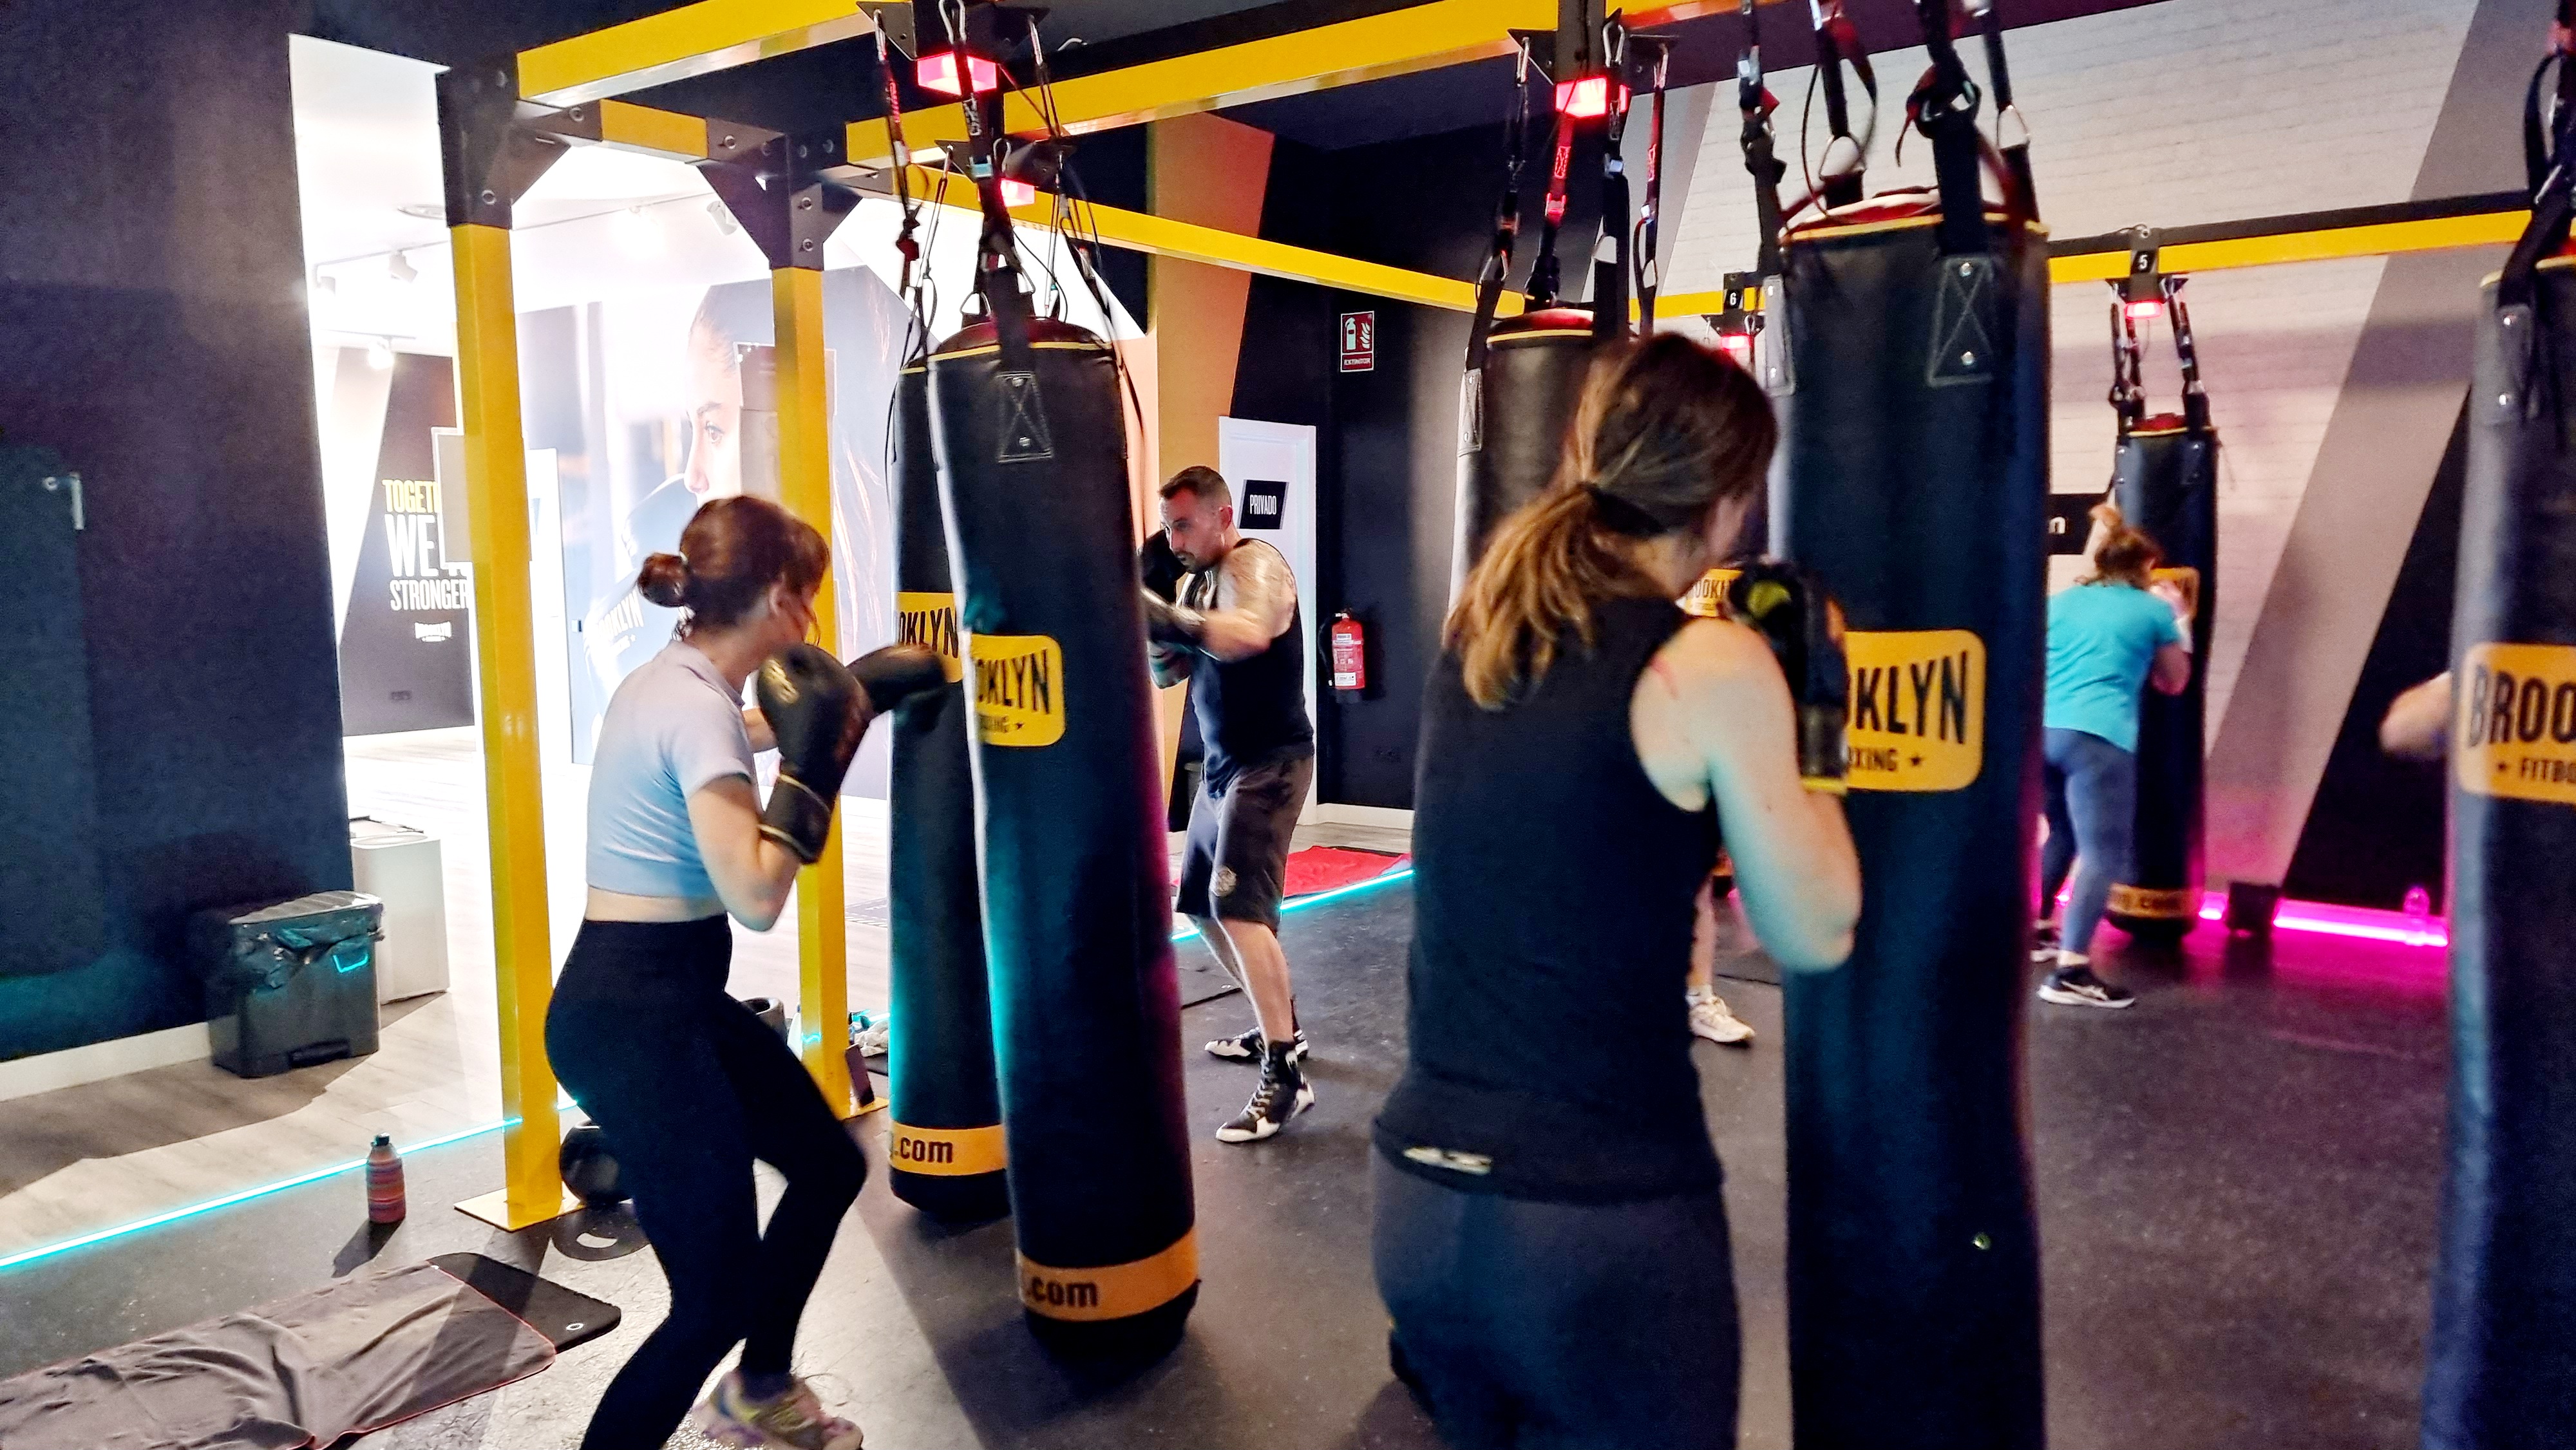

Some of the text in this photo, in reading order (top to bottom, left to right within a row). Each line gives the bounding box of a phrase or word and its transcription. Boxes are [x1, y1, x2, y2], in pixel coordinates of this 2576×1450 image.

[2139, 254, 2148, 270] 5
[1730, 292, 1737, 306] 6
[1249, 494, 1277, 515] PRIVADO
[384, 514, 439, 577] WE
[389, 578, 469, 611] STRONGER
[1846, 650, 1967, 744] KLYN
